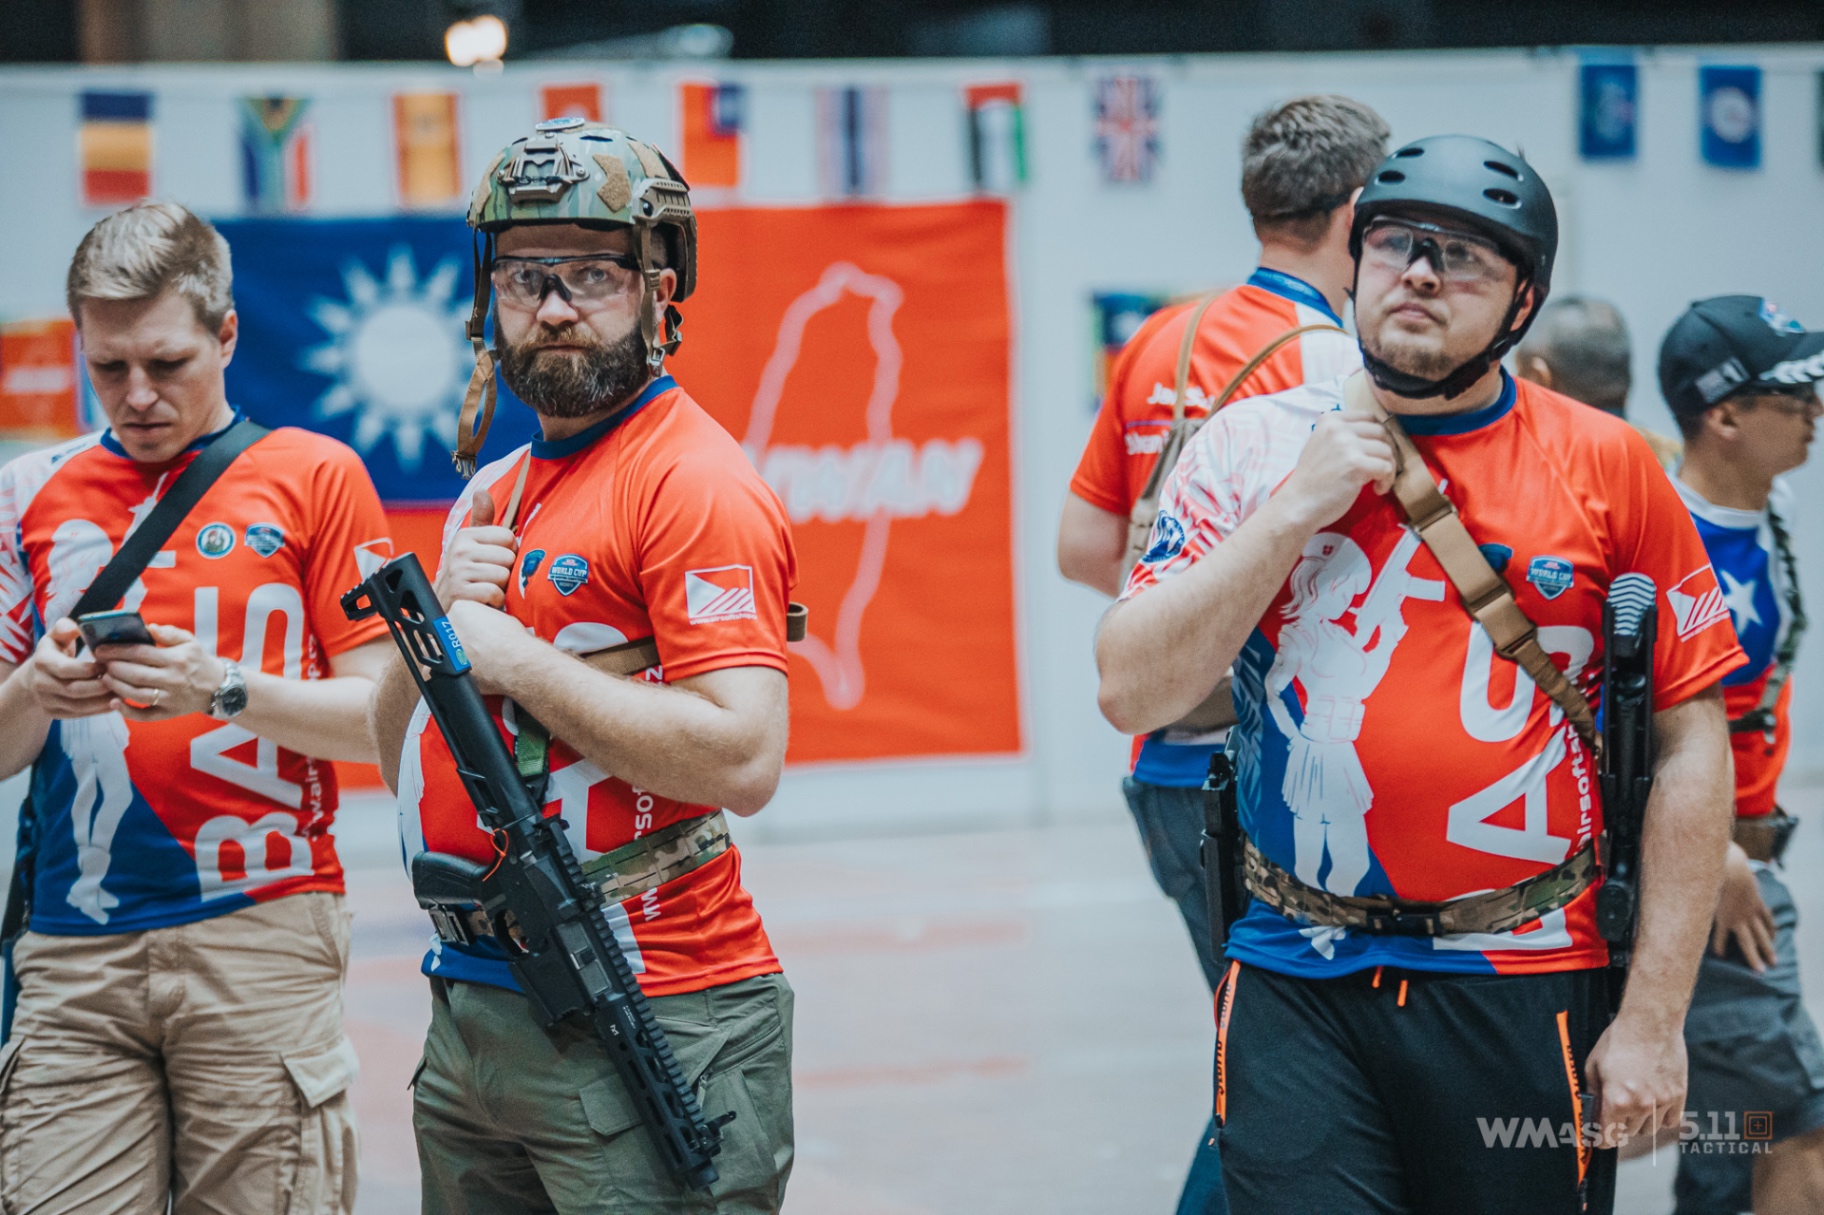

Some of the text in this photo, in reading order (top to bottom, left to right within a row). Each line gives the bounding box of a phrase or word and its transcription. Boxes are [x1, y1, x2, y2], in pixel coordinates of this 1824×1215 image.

[552, 567, 587, 577] WORLD CUP
[442, 621, 461, 648] R017
